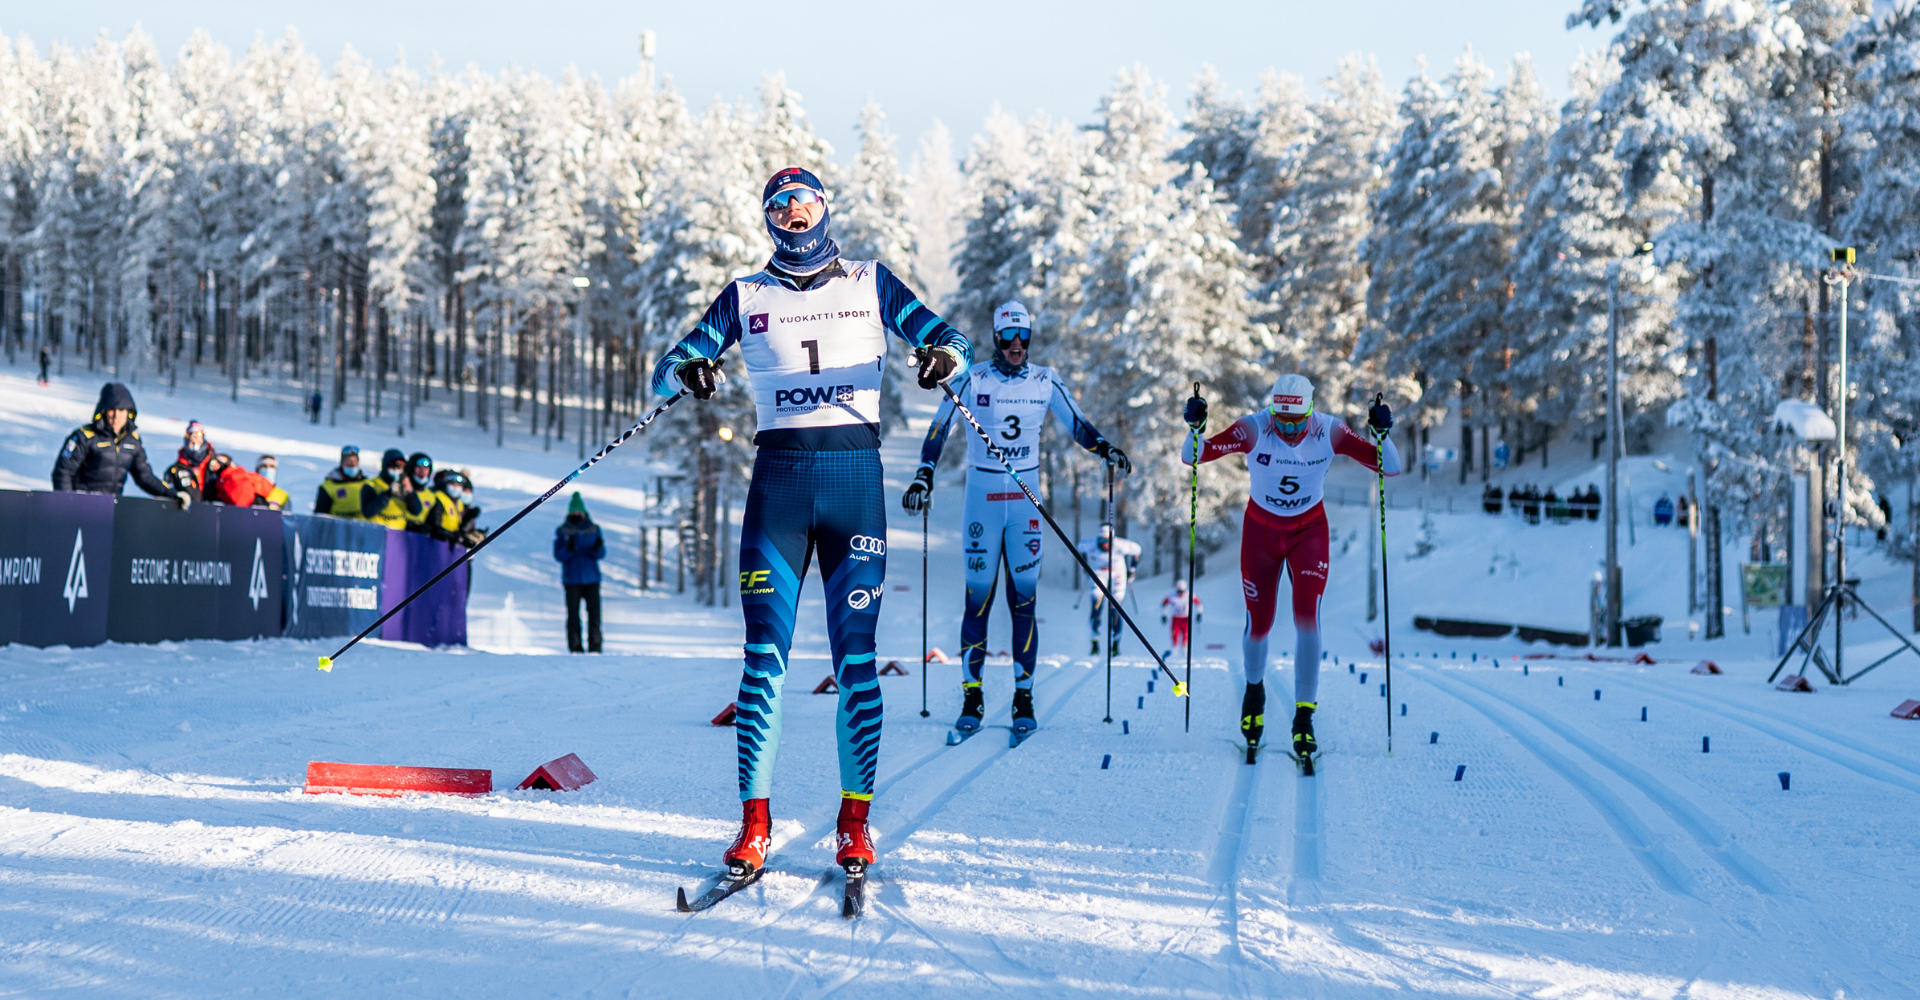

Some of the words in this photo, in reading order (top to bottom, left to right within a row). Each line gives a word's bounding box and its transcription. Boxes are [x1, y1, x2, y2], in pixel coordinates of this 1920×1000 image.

[783, 238, 817, 252] HALTI
[780, 313, 834, 324] VUOKATTI
[838, 311, 871, 319] SPORT
[801, 340, 820, 375] 1
[776, 386, 835, 406] POW
[1001, 414, 1021, 441] 3
[1275, 458, 1306, 467] VUOKATTI
[1307, 457, 1327, 466] SPORT
[1278, 475, 1300, 495] 5
[1265, 495, 1301, 508] POW
[849, 553, 870, 562] Audi
[968, 557, 987, 573] life
[1015, 558, 1041, 573] CRAFT
[0, 556, 42, 586] MPION
[131, 558, 170, 585] BECOME
[172, 560, 179, 584] A
[182, 560, 231, 586] CHAMPION
